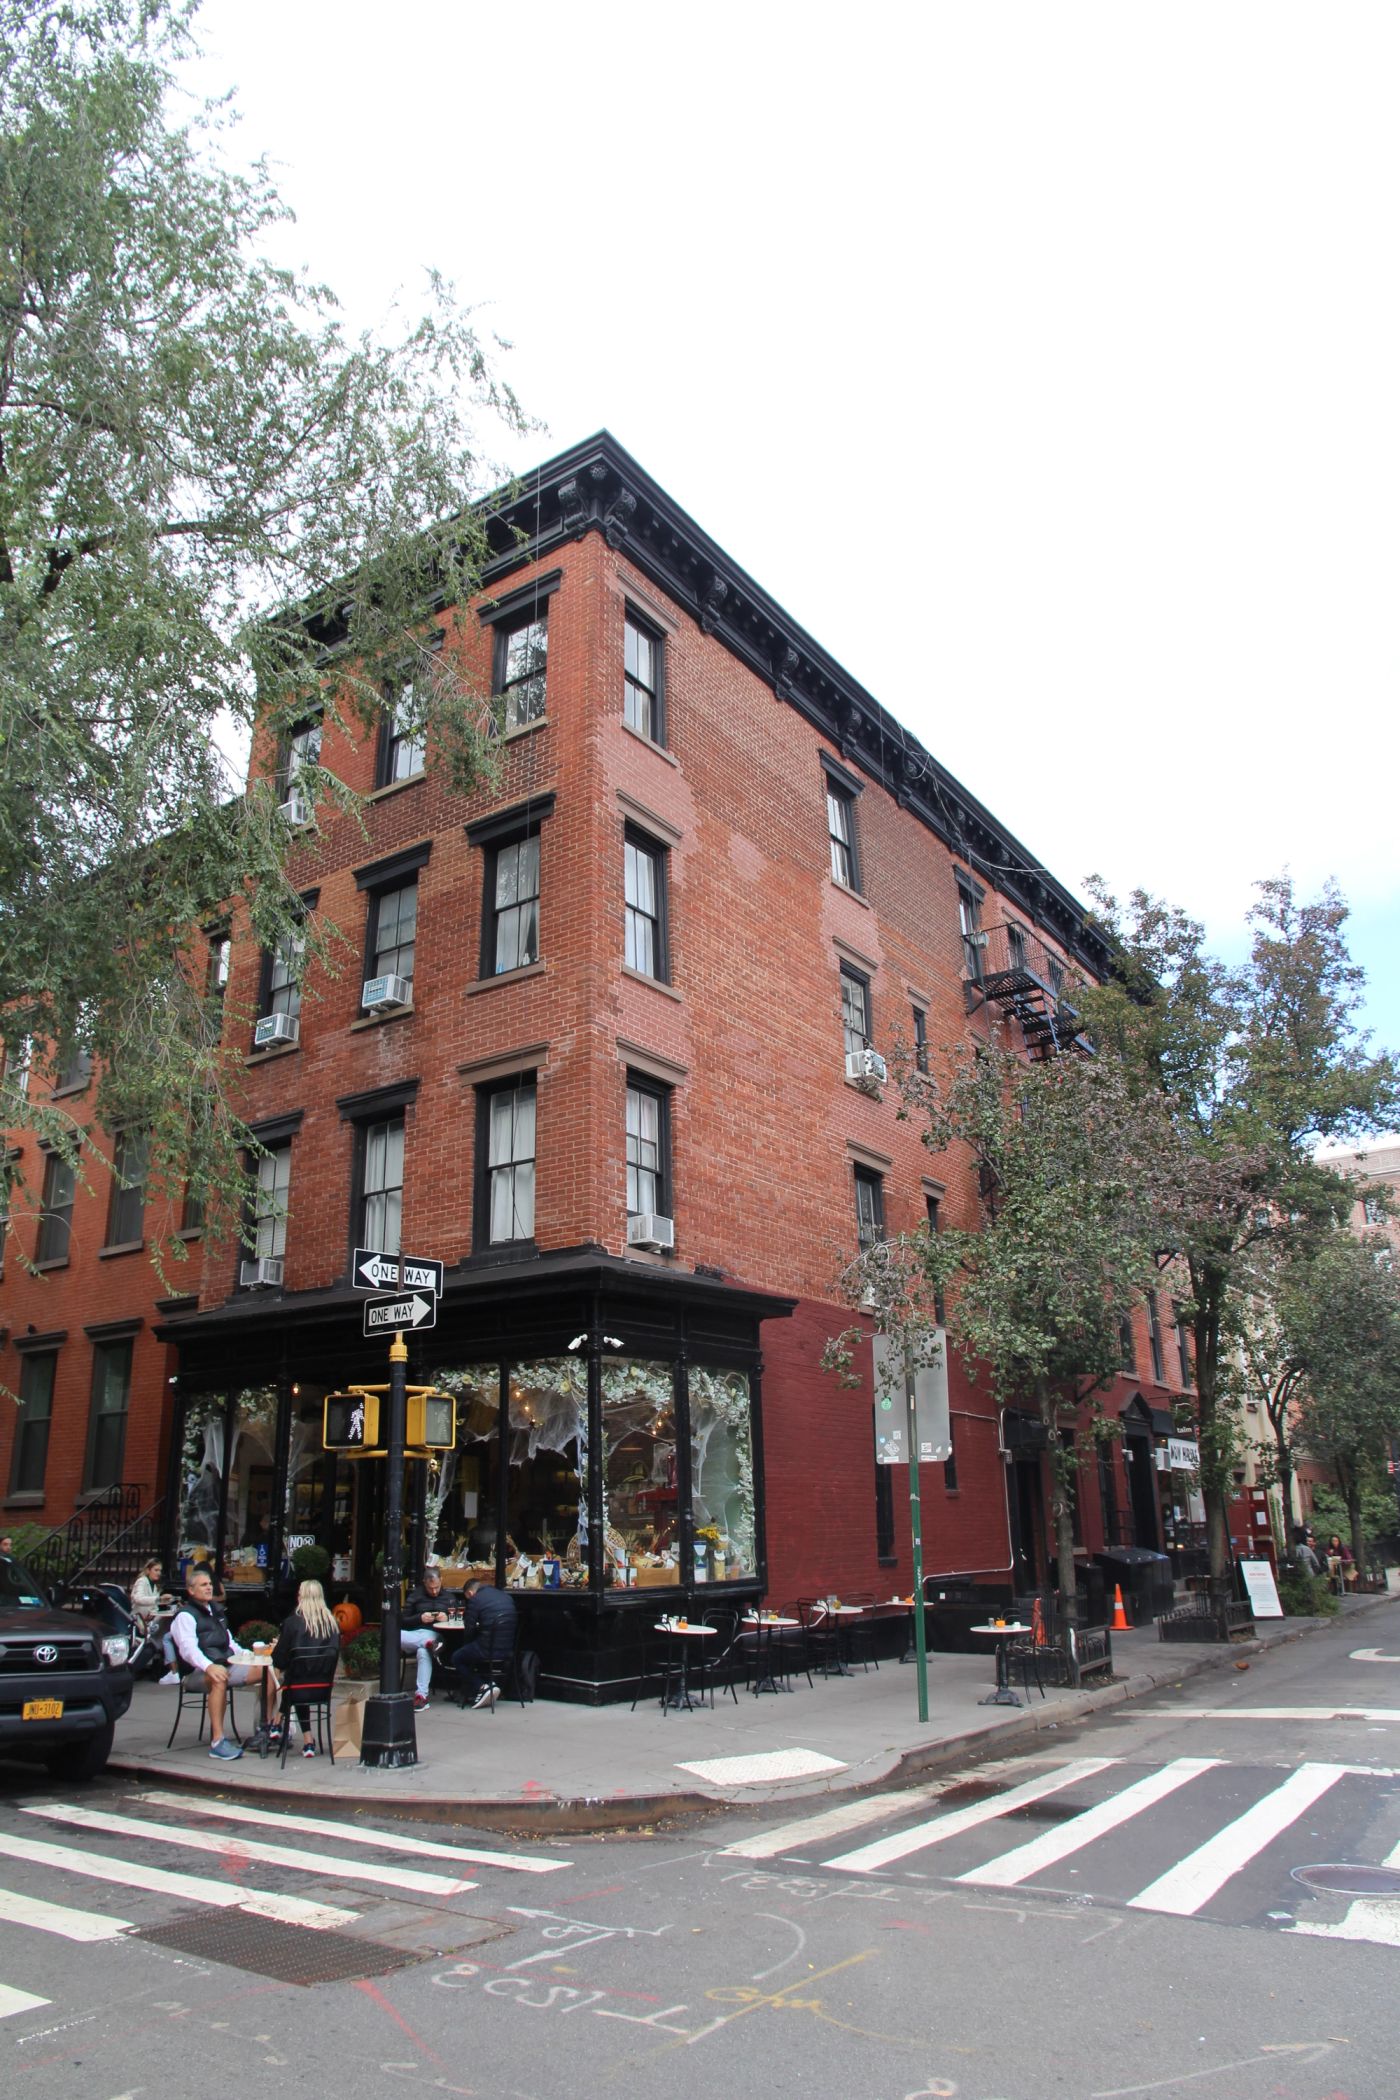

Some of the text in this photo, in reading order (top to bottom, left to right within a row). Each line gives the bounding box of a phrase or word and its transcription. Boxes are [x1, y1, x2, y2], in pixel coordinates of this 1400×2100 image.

[371, 1264, 430, 1284] ONE WAY
[371, 1303, 415, 1324] ONE WAY
[290, 1536, 303, 1548] NO
